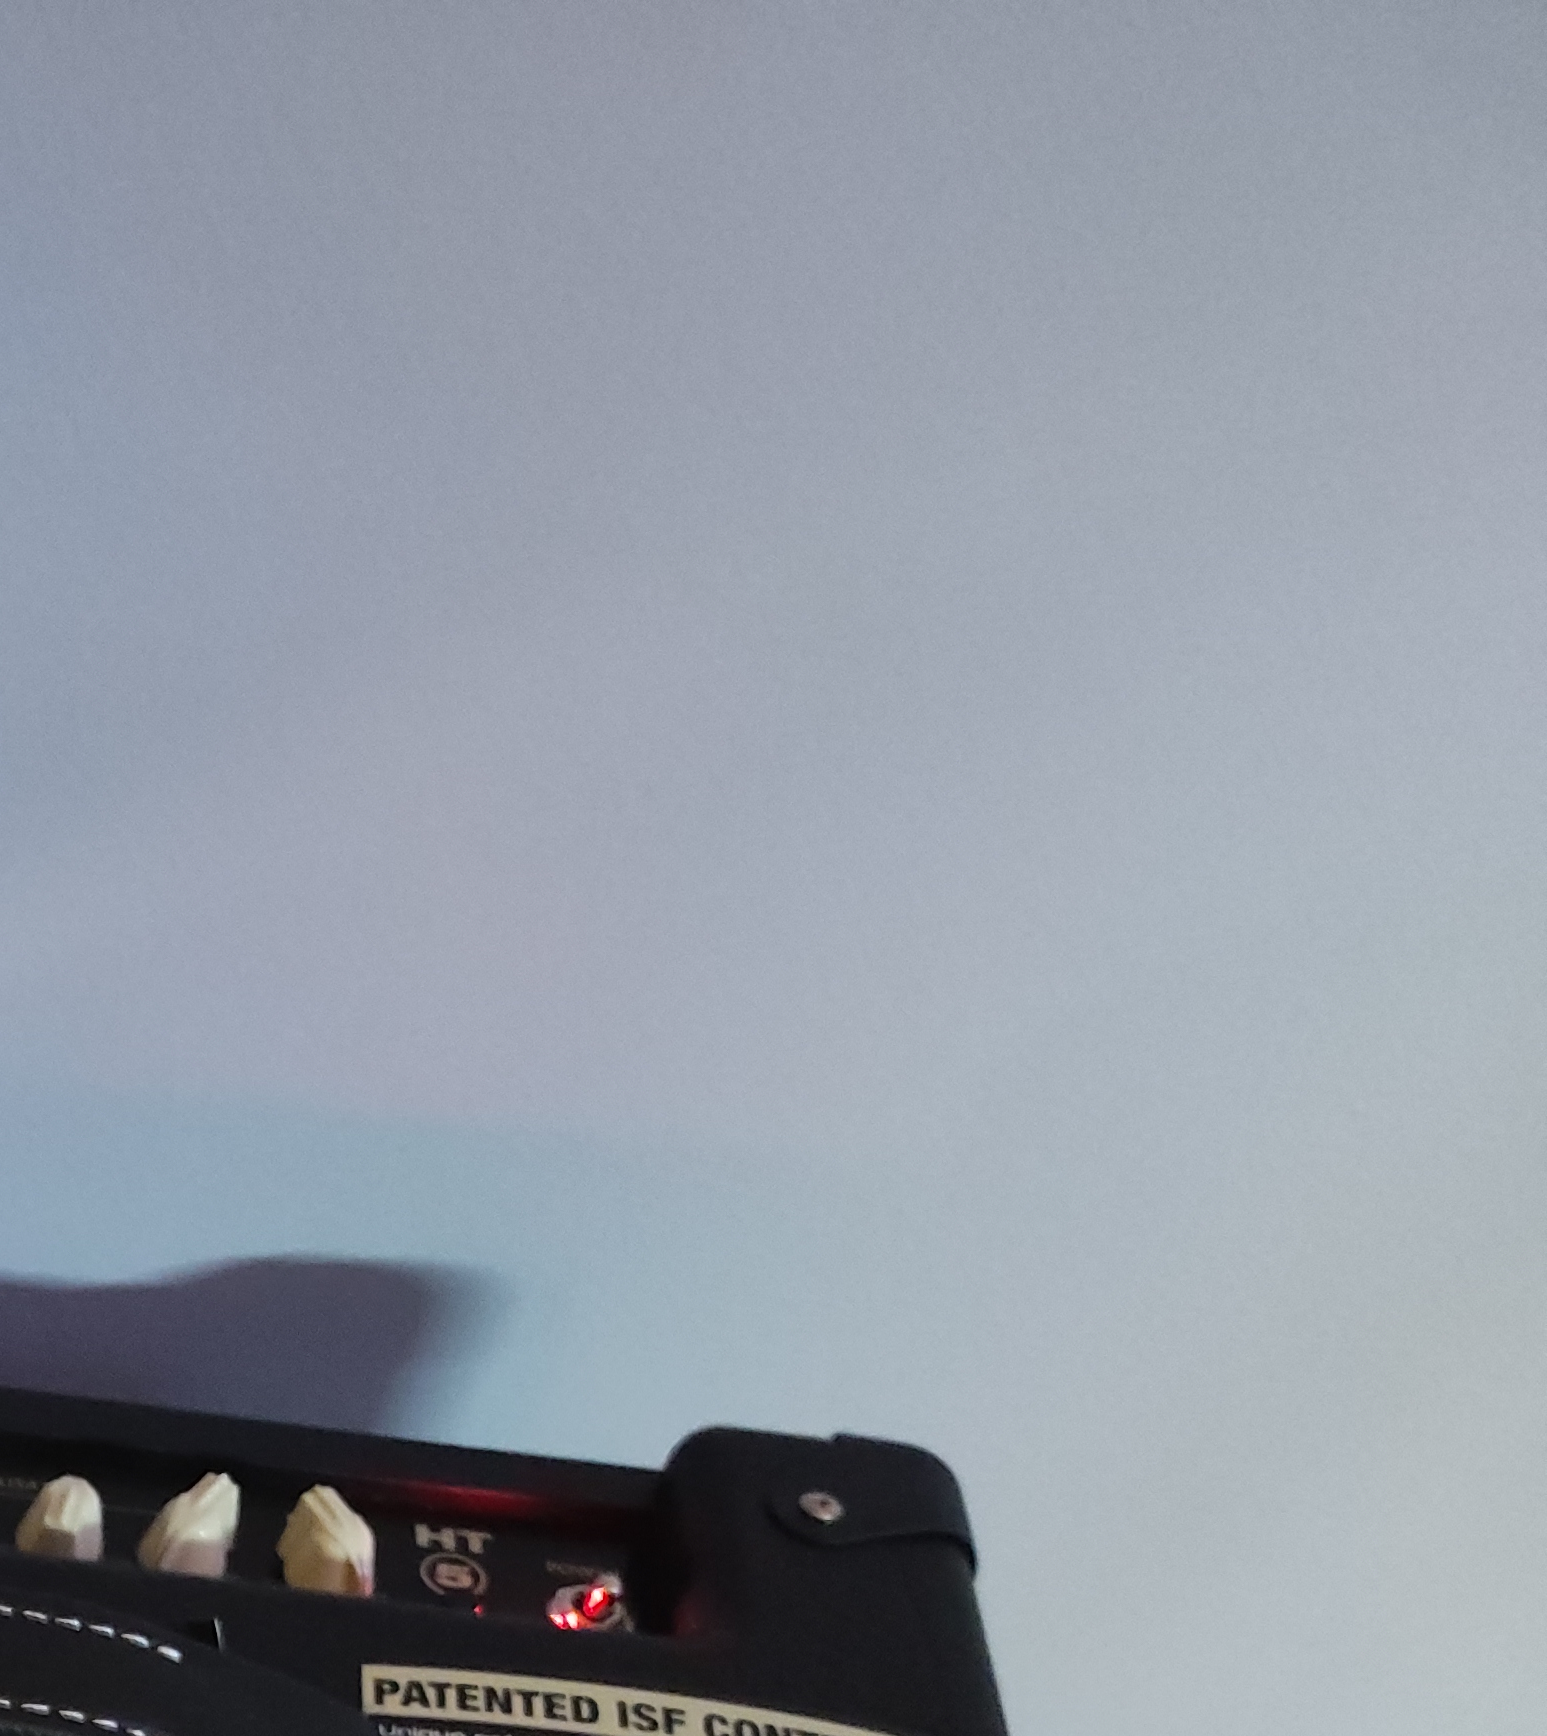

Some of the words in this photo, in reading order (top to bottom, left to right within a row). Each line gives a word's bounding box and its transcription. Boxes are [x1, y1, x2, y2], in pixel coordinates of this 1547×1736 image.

[414, 1522, 495, 1554] HT
[372, 1677, 600, 1724] PATENTED
[616, 1700, 686, 1735] ISF
